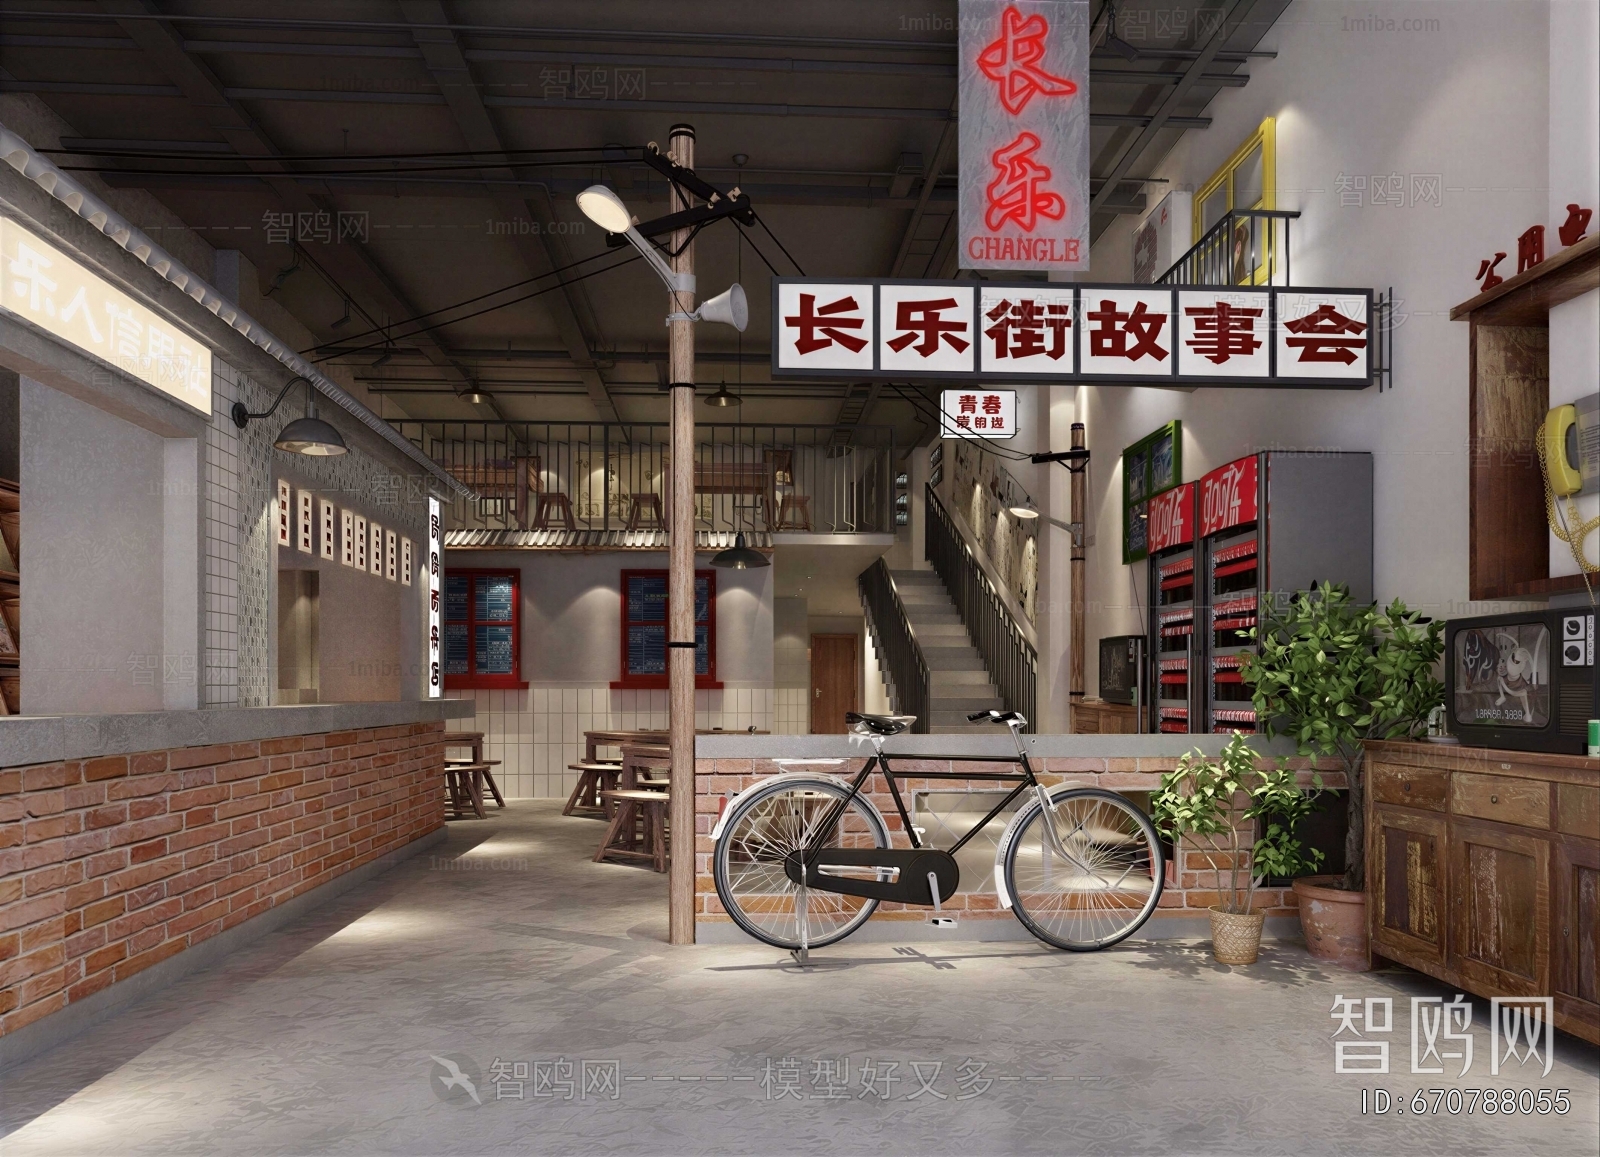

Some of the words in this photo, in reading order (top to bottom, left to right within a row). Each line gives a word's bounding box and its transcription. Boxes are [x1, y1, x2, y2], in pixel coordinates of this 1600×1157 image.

[977, 6, 1077, 232] 长乐
[968, 236, 1080, 262] CHANGLE
[784, 293, 1367, 366] 长乐街故事会
[959, 395, 1001, 414] 青春
